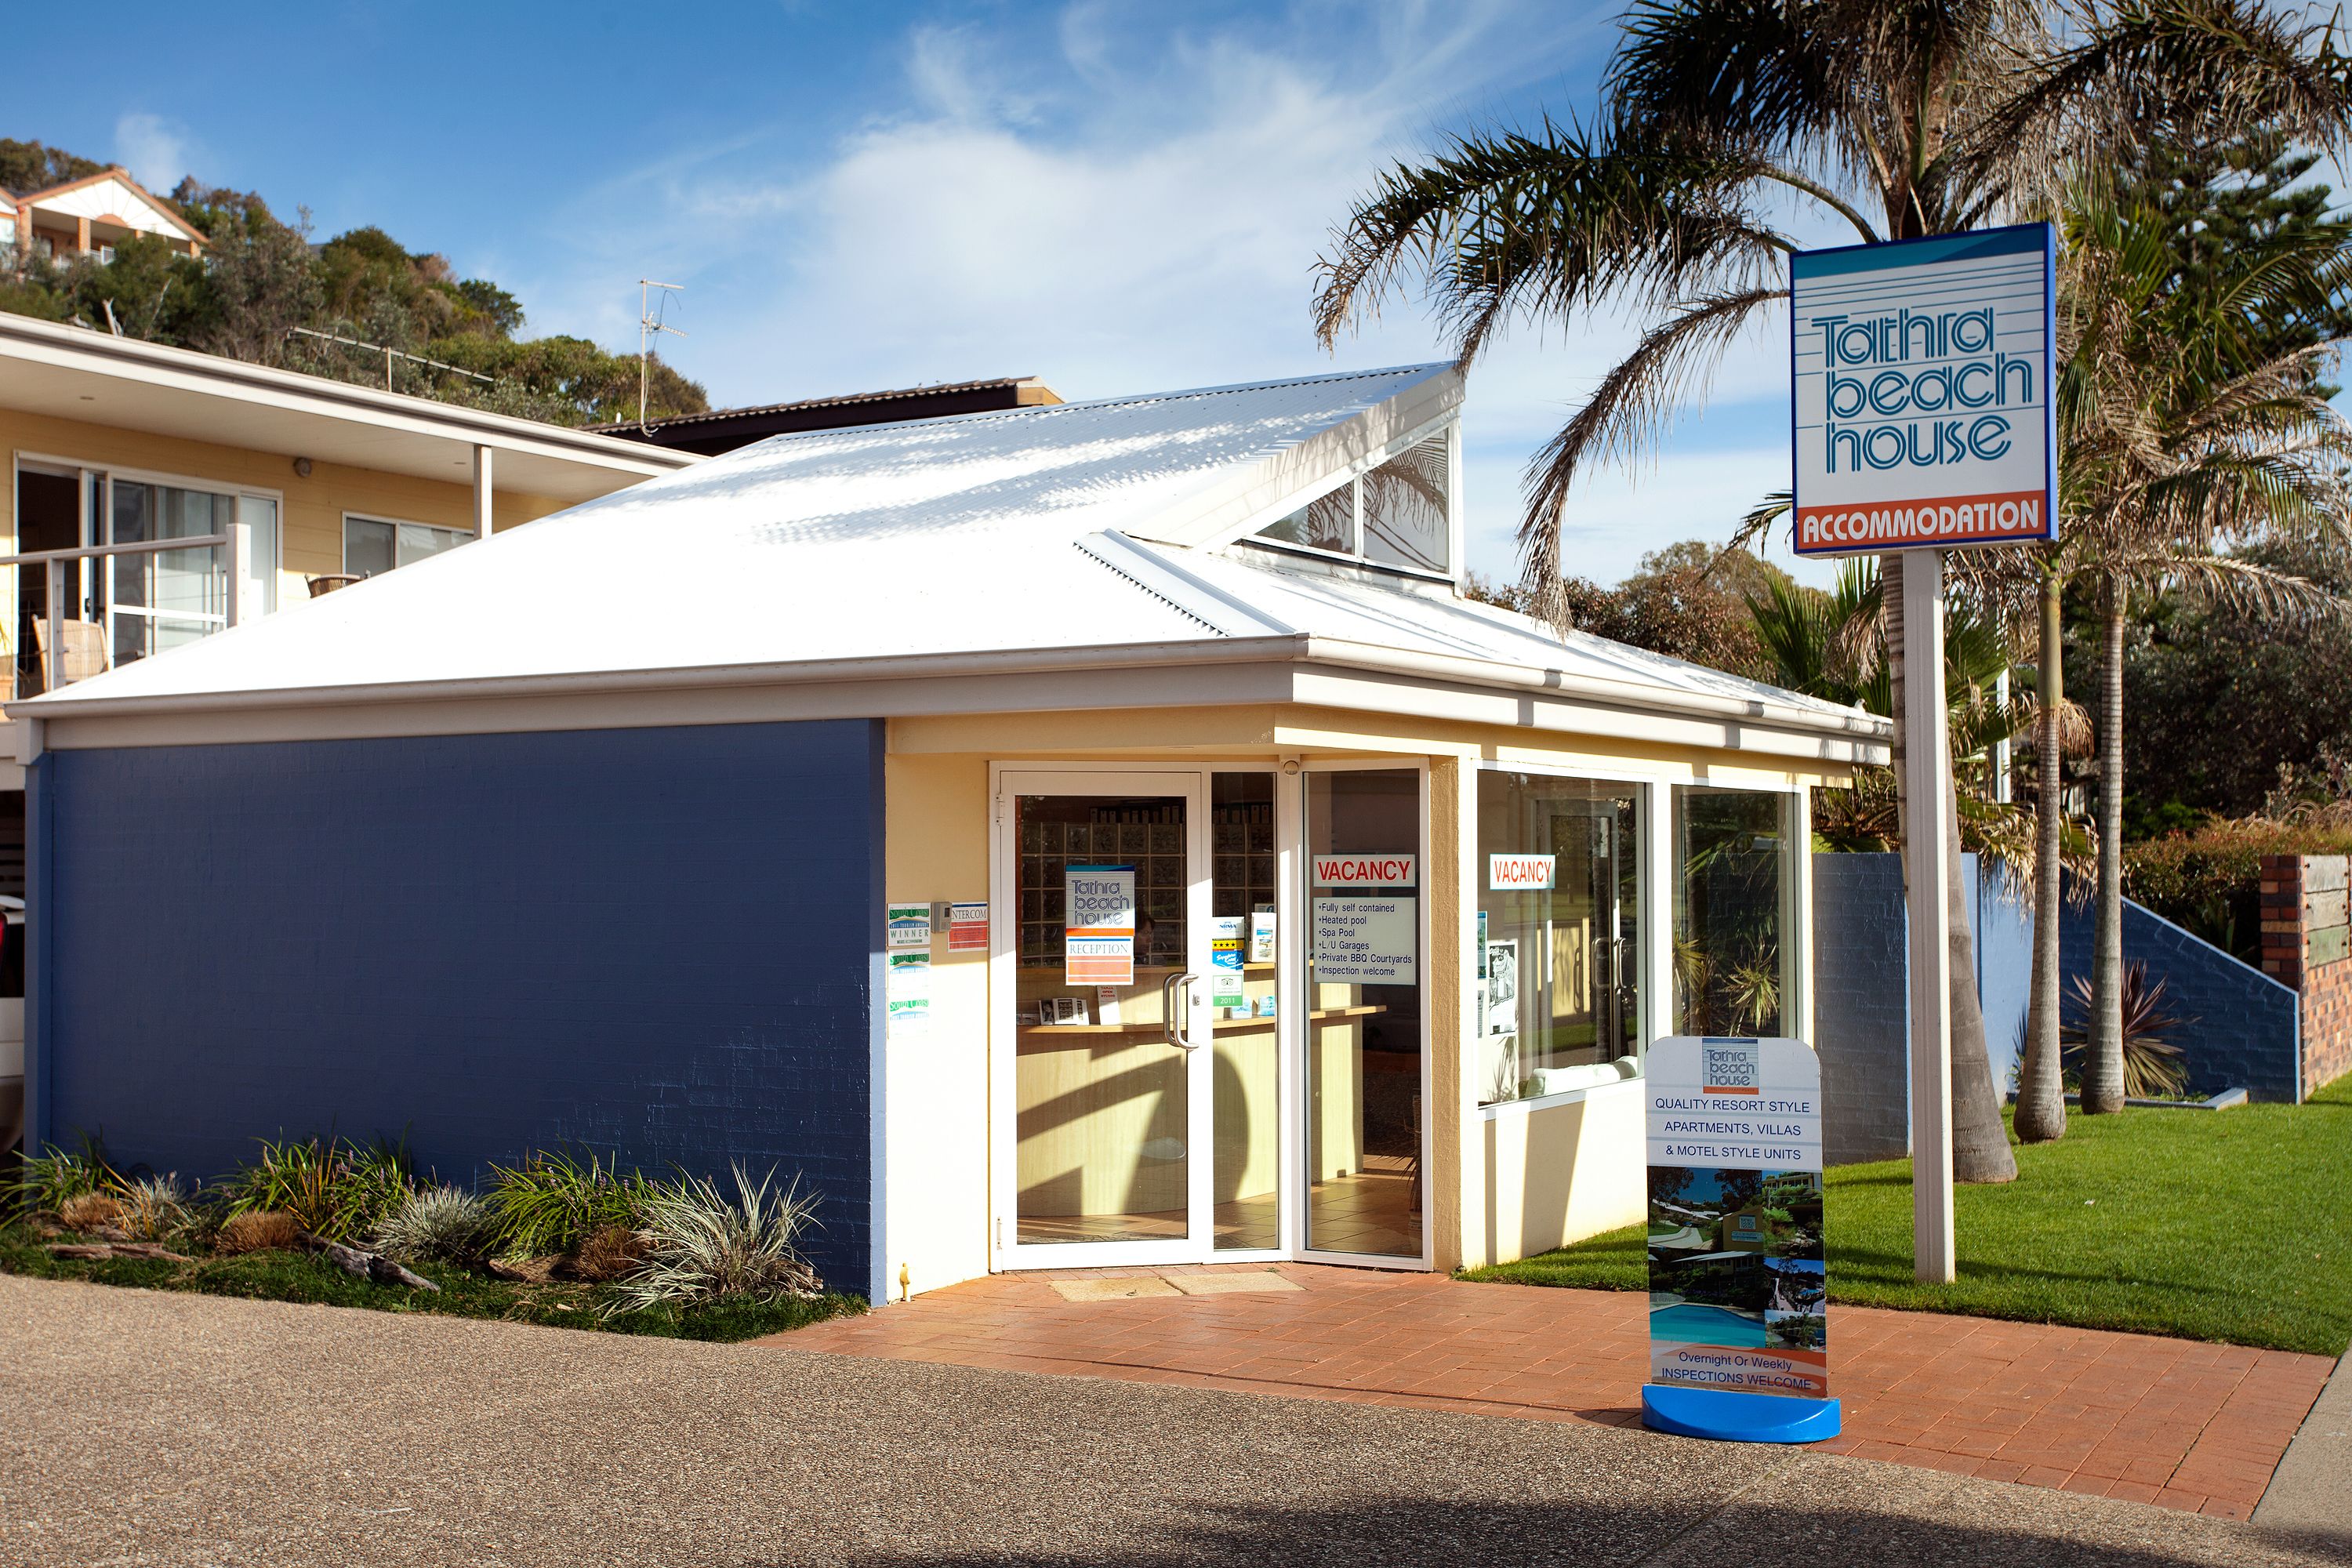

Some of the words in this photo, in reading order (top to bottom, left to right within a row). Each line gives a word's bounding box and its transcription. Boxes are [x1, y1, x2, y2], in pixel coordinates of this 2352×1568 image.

[1812, 307, 1994, 368] Tathra
[1826, 352, 2032, 420] beach
[1826, 415, 2012, 474] house
[1802, 499, 2038, 543] ACCOMMODATION
[1317, 861, 1410, 880] VACANCY
[1494, 861, 1551, 883] VACANCY
[1071, 880, 1120, 895] Tathra
[1074, 895, 1130, 910] beach
[1342, 903, 1356, 912] self
[1359, 903, 1395, 913] contained
[952, 909, 986, 920] NTERCOM
[1074, 910, 1124, 925] house
[1351, 916, 1367, 926] pool
[890, 929, 929, 938] WINNER
[1339, 928, 1355, 937] Pool
[1069, 944, 1128, 954] RECEPTION
[1339, 941, 1370, 952] Garages
[1351, 953, 1367, 963] BBQ
[1370, 954, 1412, 965] Courtyards
[1363, 967, 1396, 975] welcome
[1706, 1050, 1747, 1062] Tathra
[1710, 1062, 1755, 1074] beach
[1710, 1073, 1751, 1086] house
[1655, 1098, 1708, 1109] QUALITY
[1712, 1100, 1765, 1112] RESORT
[1769, 1102, 1810, 1112] STYLE
[1664, 1122, 1753, 1136] APARTMENTS,
[1757, 1124, 1801, 1136] VILLAS
[1665, 1145, 1674, 1155] &
[1677, 1145, 1718, 1157] MOTEL
[1722, 1147, 1760, 1159] STYLE
[1764, 1149, 1801, 1160] UNITS
[1679, 1352, 1732, 1367] Overnight
[1734, 1356, 1749, 1367] Or
[1751, 1356, 1792, 1372] Weekly
[1661, 1368, 1744, 1384] INSPECTIONS
[1747, 1374, 1812, 1390] WELCOME
